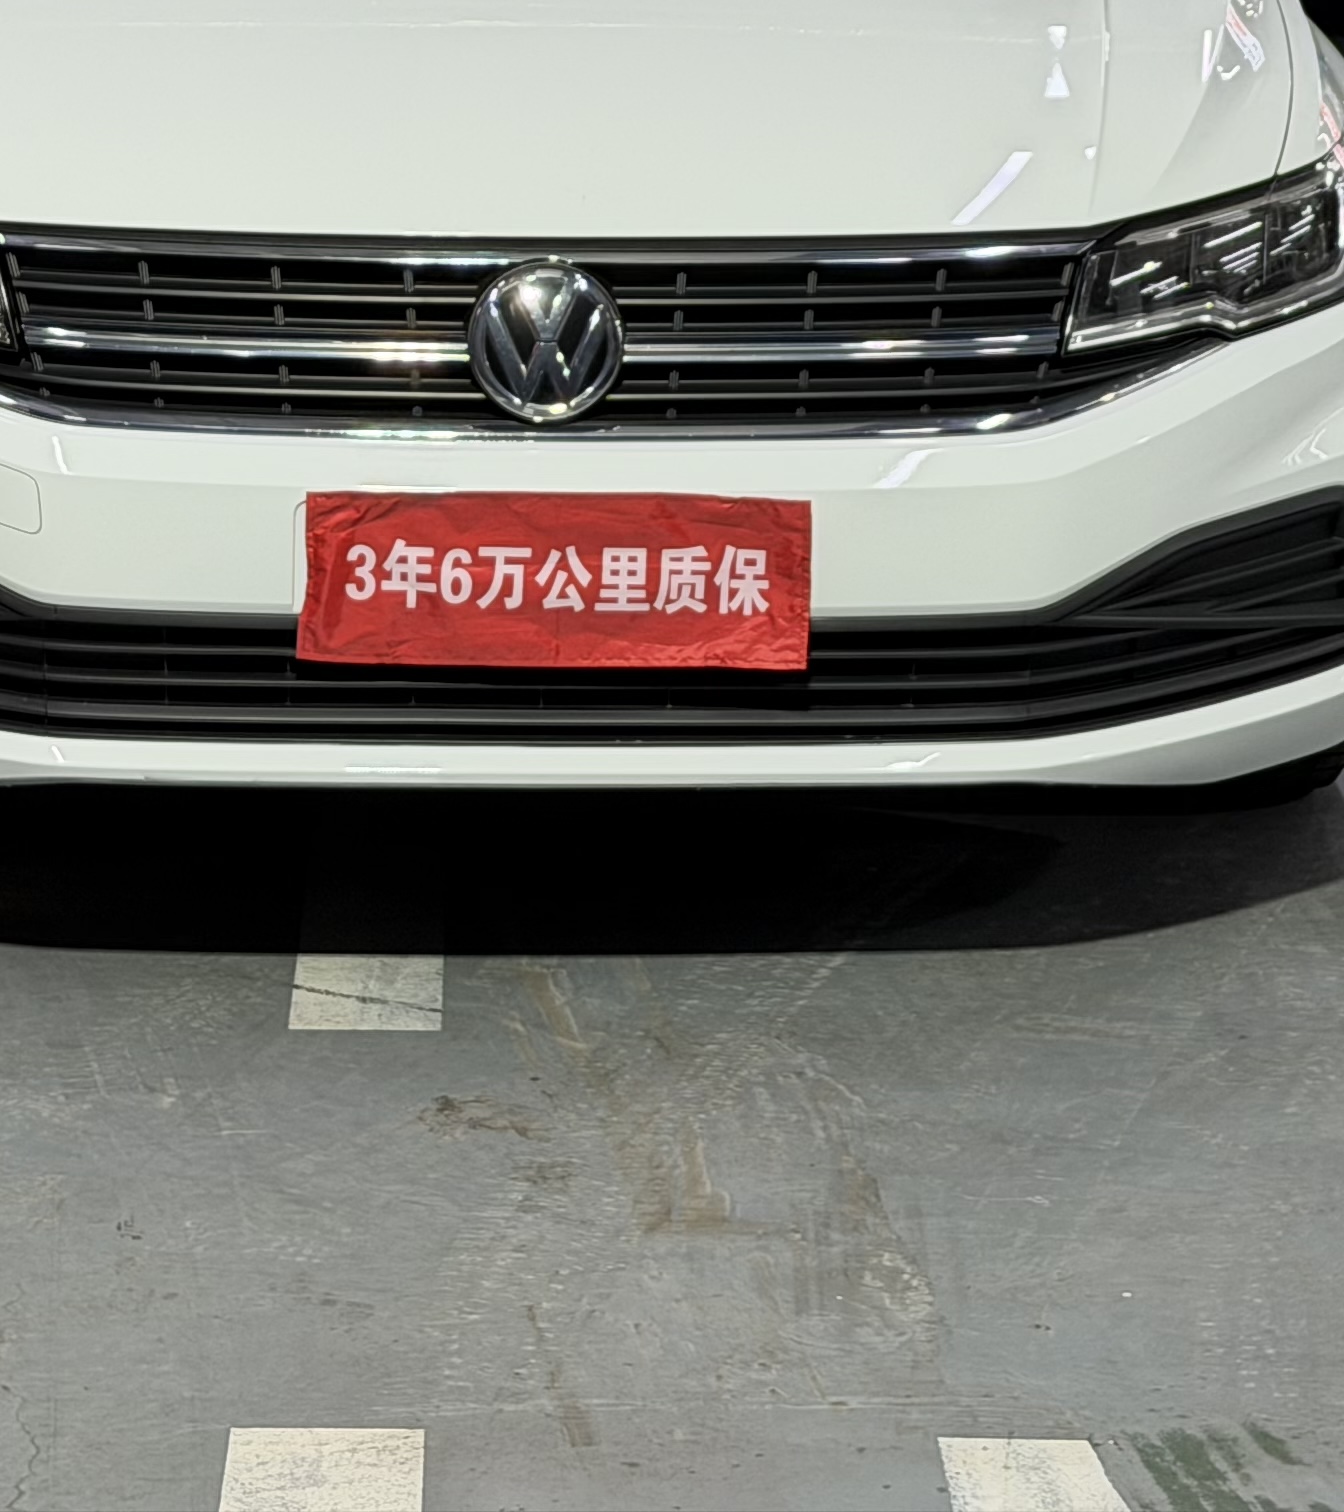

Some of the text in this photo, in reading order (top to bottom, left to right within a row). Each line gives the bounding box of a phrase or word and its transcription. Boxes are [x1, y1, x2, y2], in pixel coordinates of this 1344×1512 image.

[345, 539, 770, 616] 3年6万公里质保
